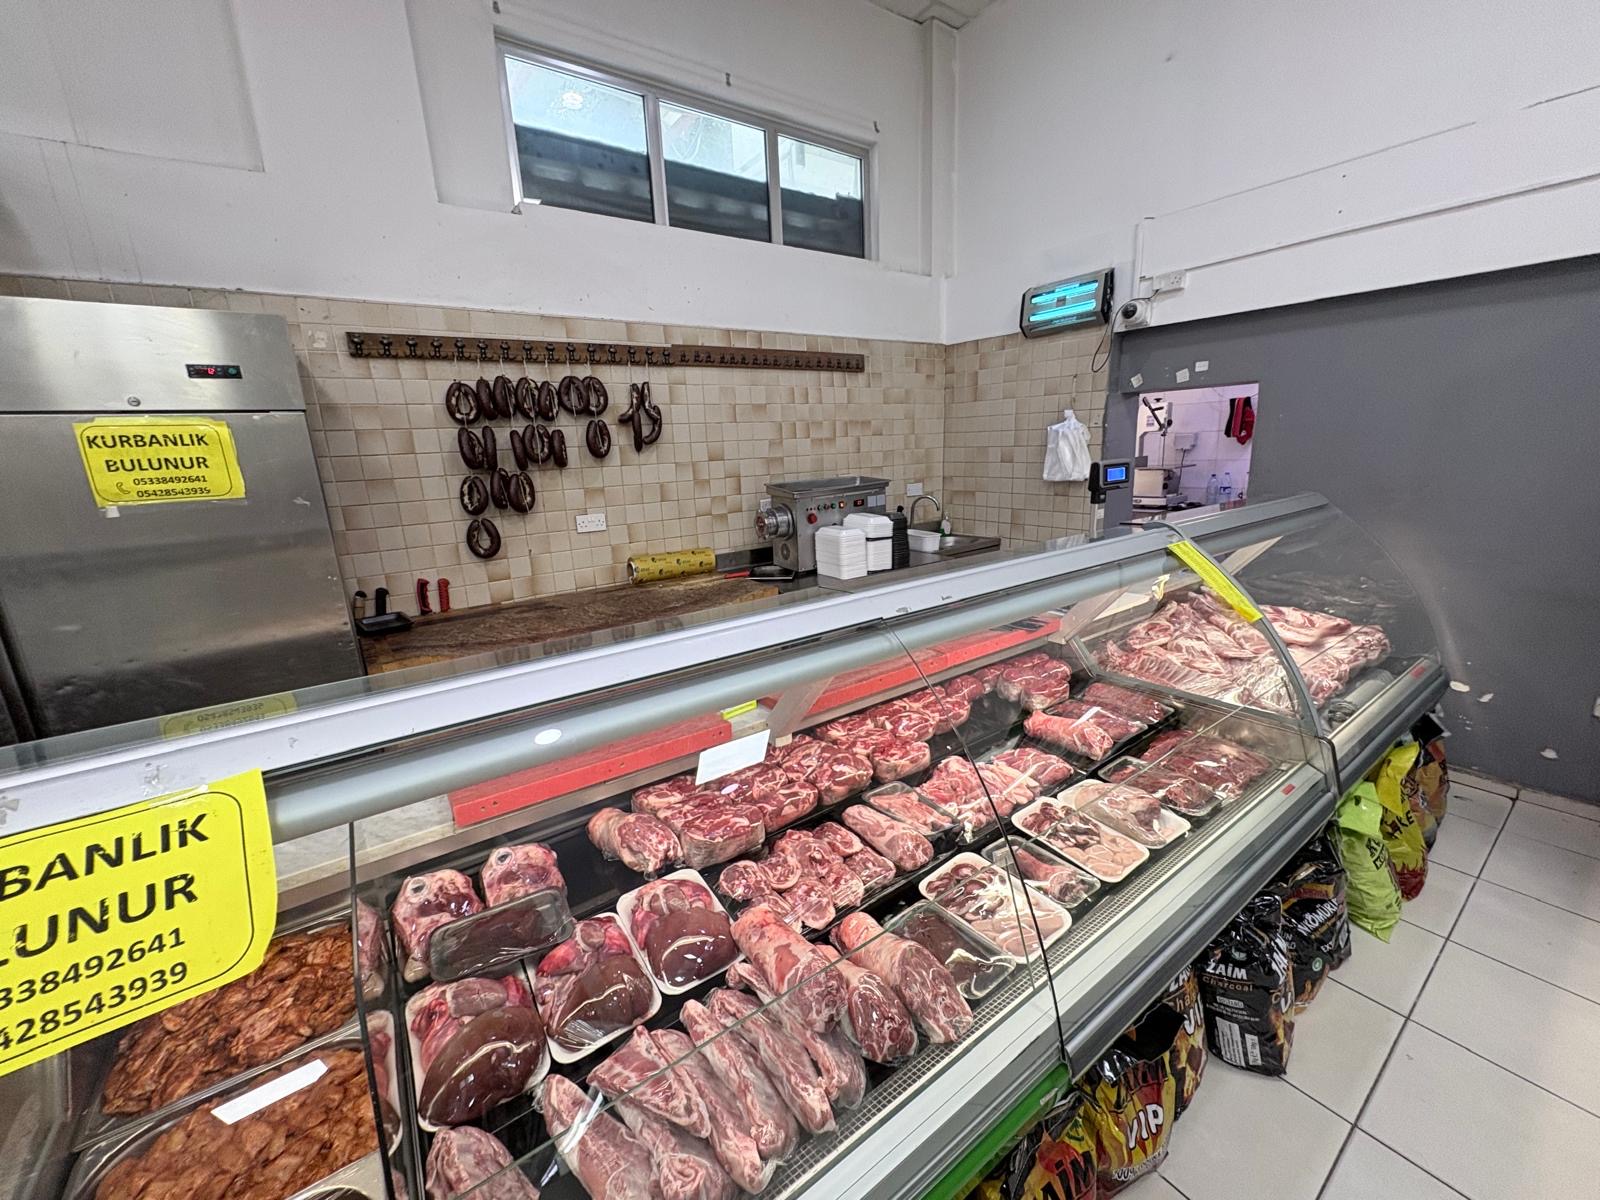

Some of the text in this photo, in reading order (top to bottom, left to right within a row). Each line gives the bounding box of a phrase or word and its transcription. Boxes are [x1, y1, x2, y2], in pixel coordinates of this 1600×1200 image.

[86, 433, 209, 449] KURBANLIK
[105, 456, 210, 472] BULUNUR
[133, 475, 207, 486] 05338492641
[1202, 976, 1253, 992] Charcoal
[1127, 1103, 1164, 1150] VIP
